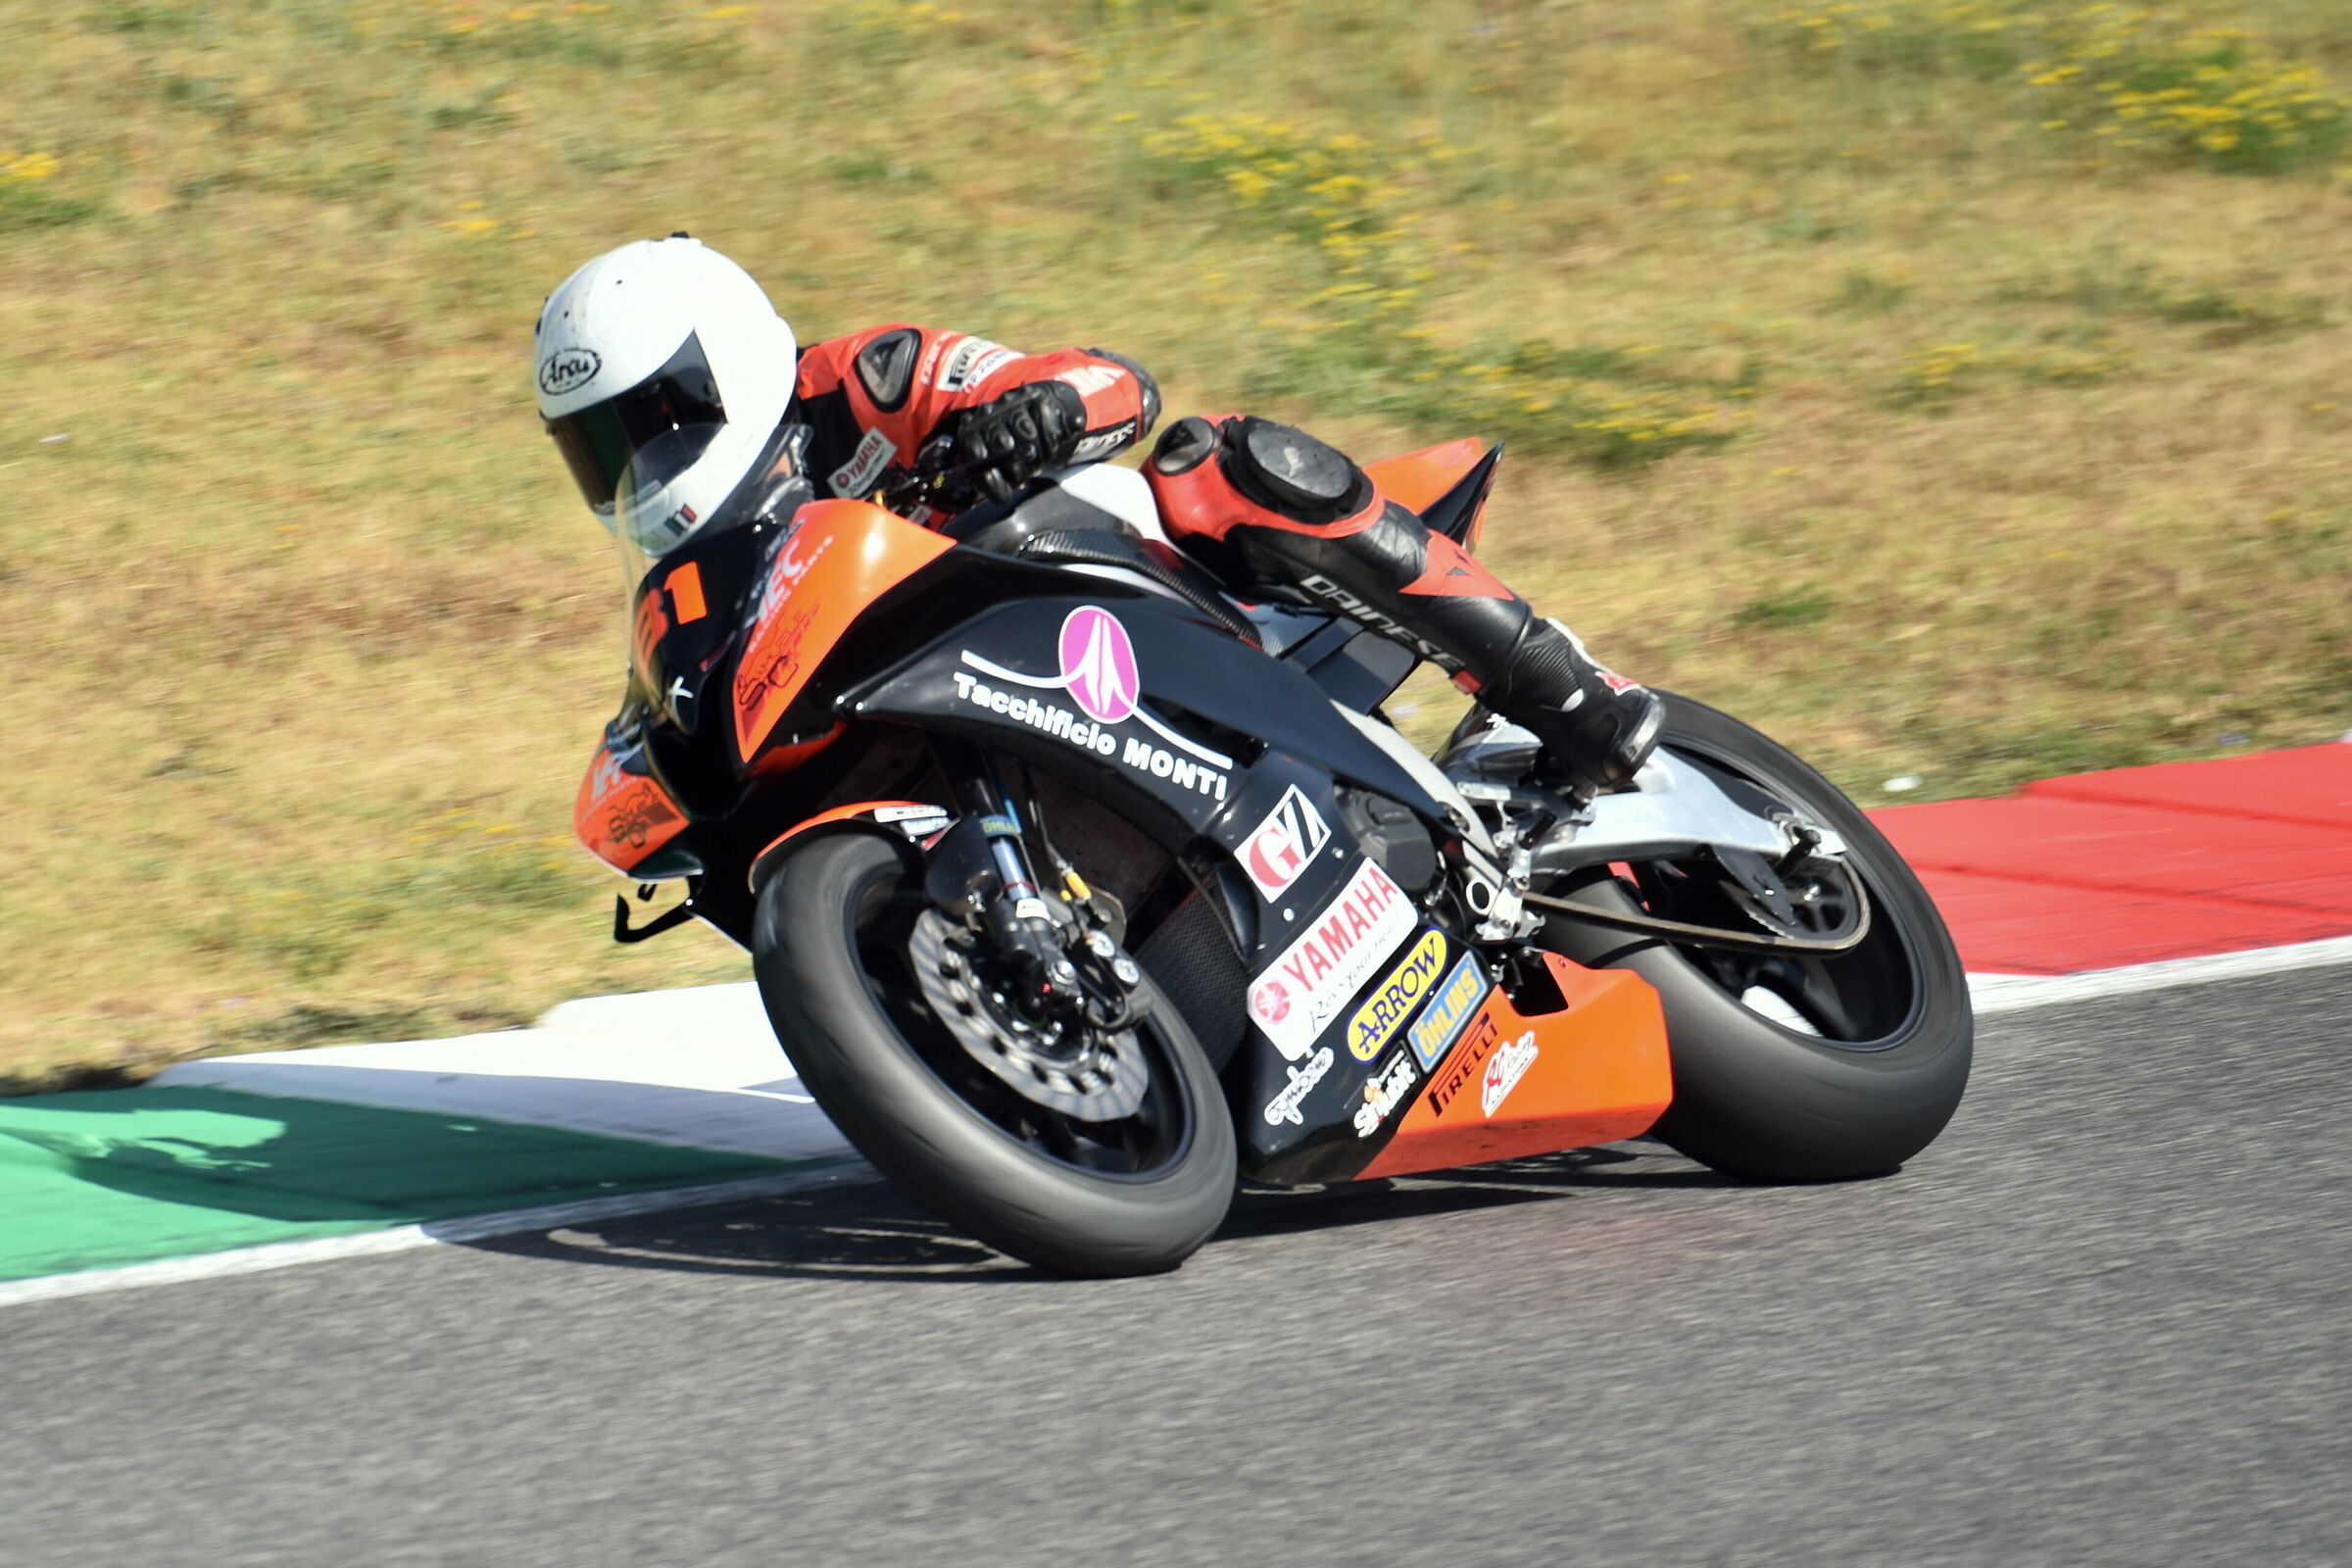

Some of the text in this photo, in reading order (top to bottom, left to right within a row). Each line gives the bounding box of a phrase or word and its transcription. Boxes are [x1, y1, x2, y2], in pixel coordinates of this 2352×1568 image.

[1299, 573, 1466, 669] DAINESE
[953, 671, 1228, 802] Tacchificio MONTI
[1283, 866, 1398, 993] YAMAHA
[1357, 937, 1437, 1054] ARROW
[1428, 1012, 1498, 1117] PIRELLI
